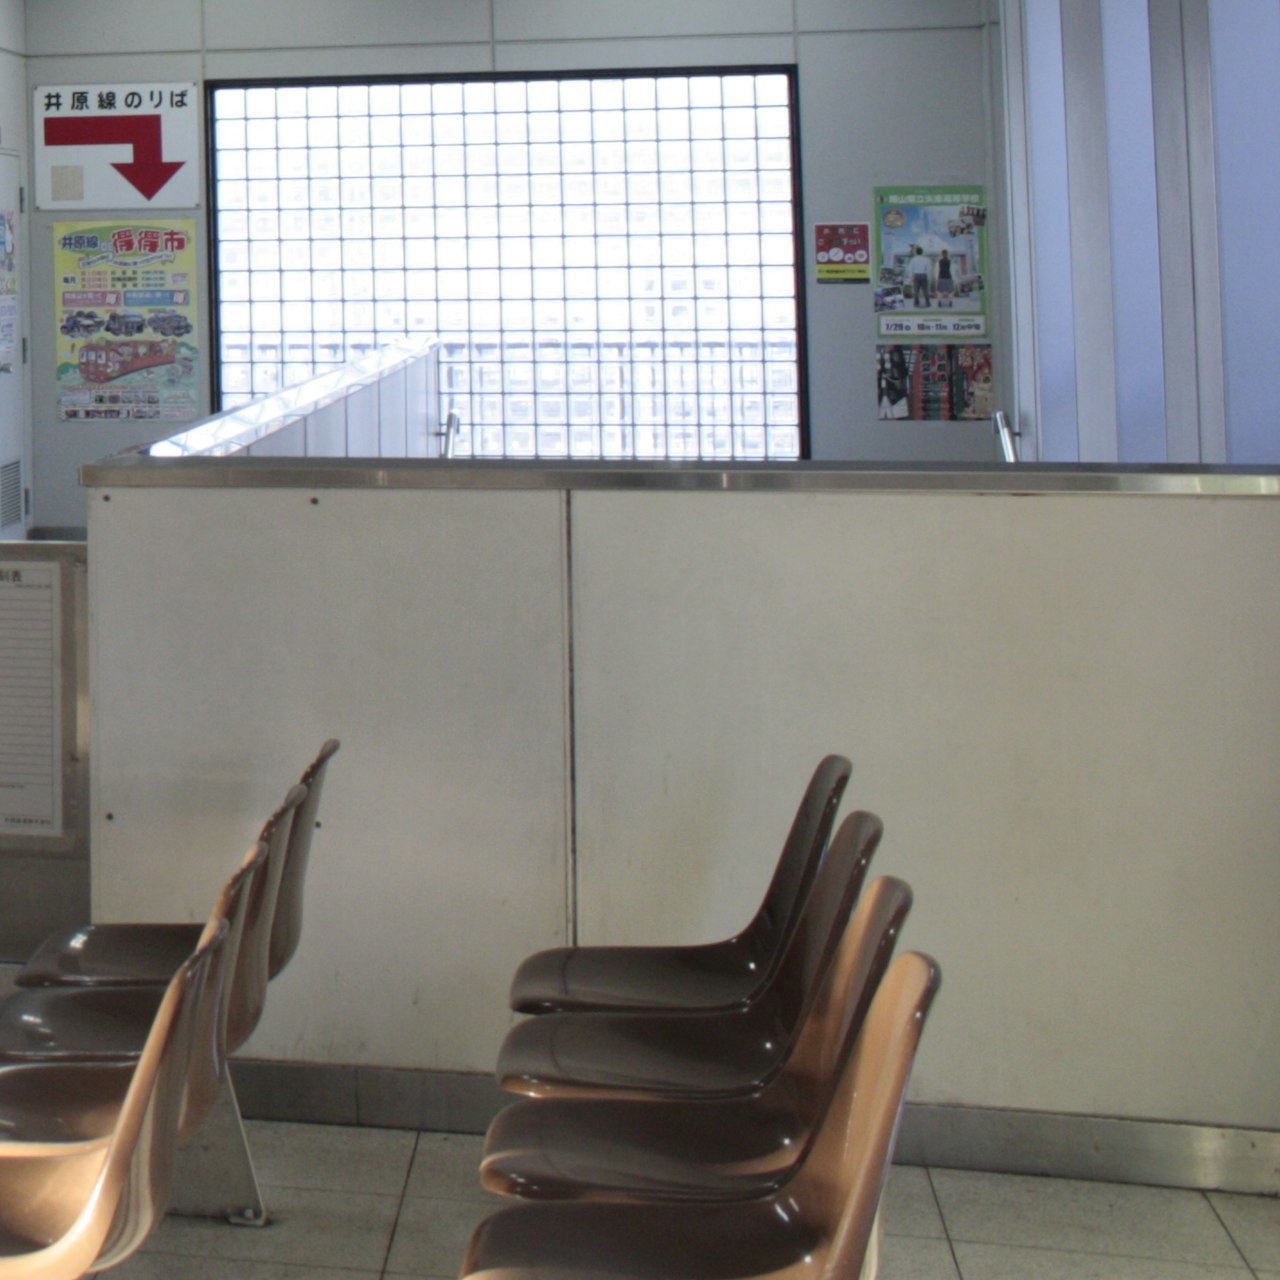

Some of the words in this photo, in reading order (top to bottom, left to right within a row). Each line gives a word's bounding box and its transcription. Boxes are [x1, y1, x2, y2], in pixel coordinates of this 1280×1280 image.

[43, 88, 189, 112] 井原線のりば
